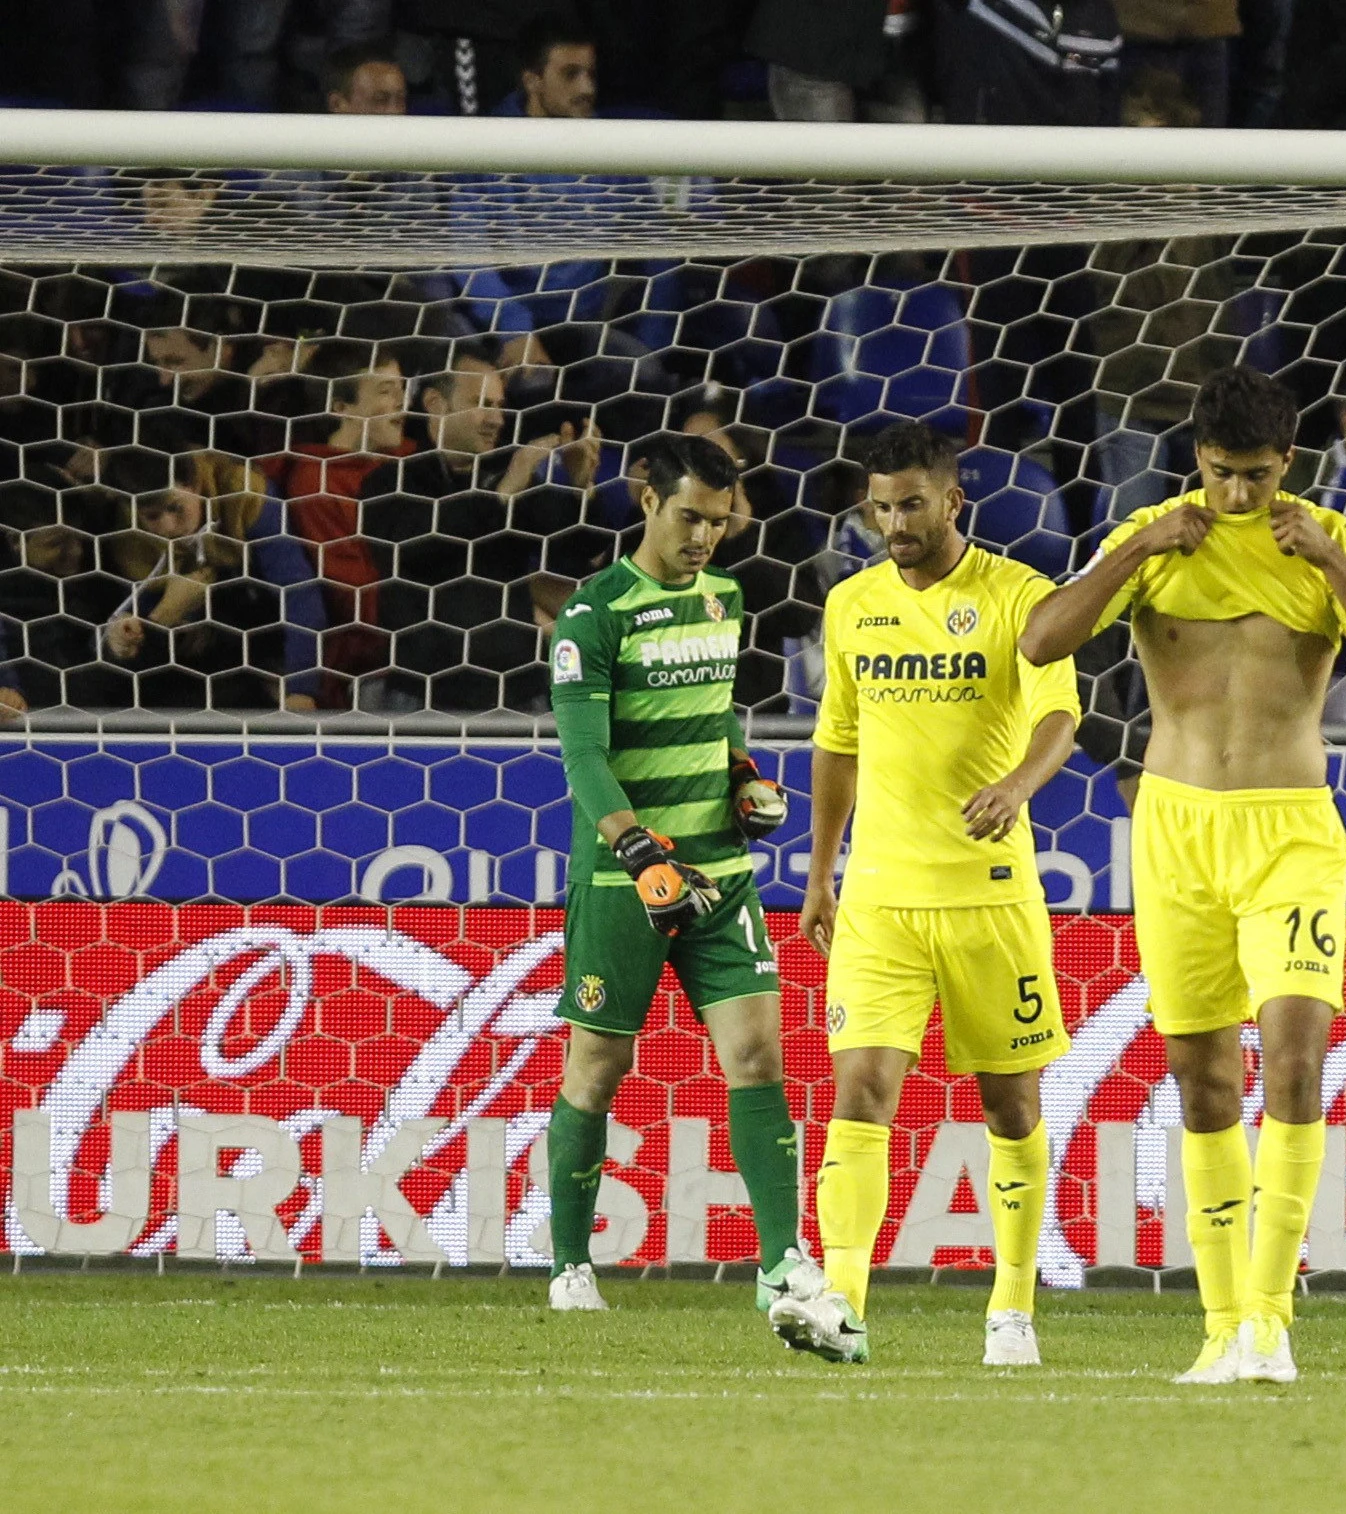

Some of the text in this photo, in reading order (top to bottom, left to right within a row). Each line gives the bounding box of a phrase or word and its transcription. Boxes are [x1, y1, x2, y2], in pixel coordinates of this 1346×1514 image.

[855, 651, 987, 681] PAMESA
[1284, 905, 1337, 957] 16
[1013, 975, 1043, 1024] 5
